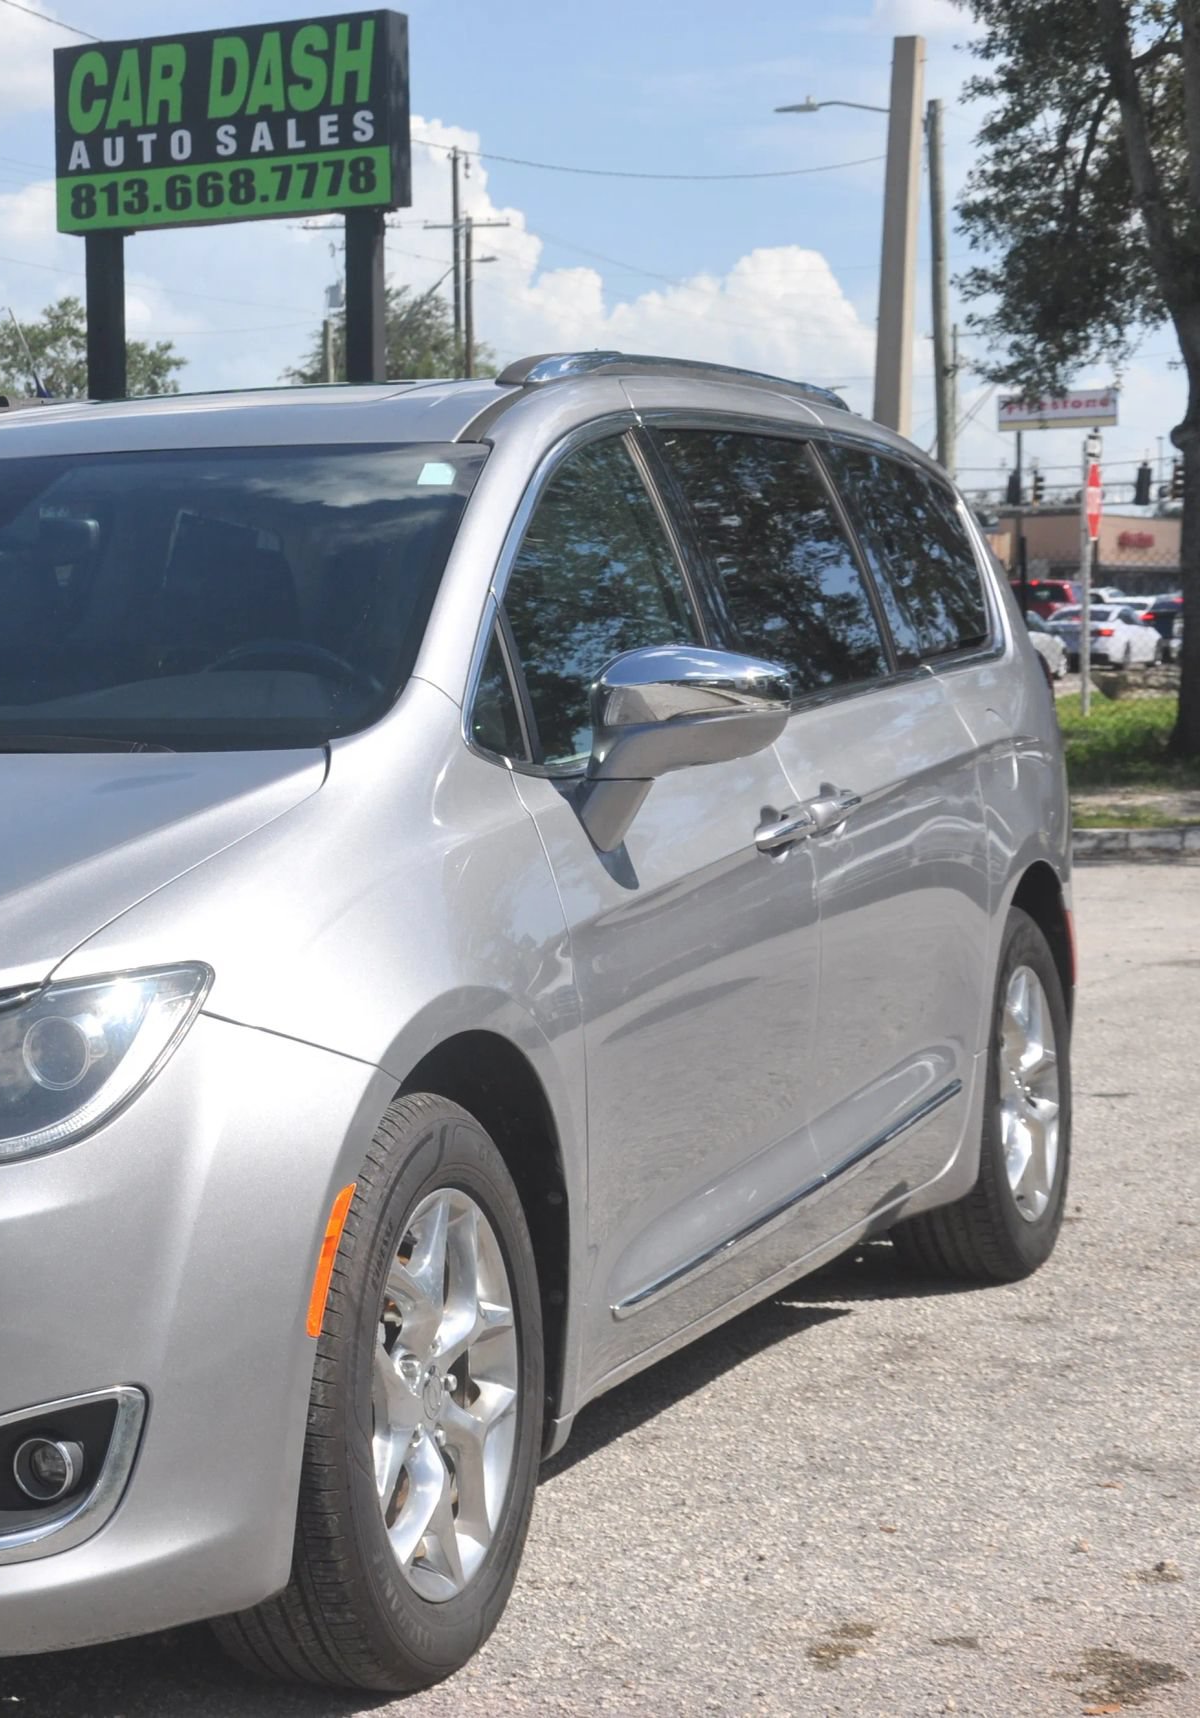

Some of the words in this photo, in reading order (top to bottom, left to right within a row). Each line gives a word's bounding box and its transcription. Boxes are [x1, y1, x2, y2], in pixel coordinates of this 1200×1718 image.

[67, 43, 187, 135] CAR
[207, 19, 376, 119] DASH
[68, 129, 192, 171] AUTO
[216, 110, 375, 156] SALES
[70, 156, 377, 220] 813.668.7778
